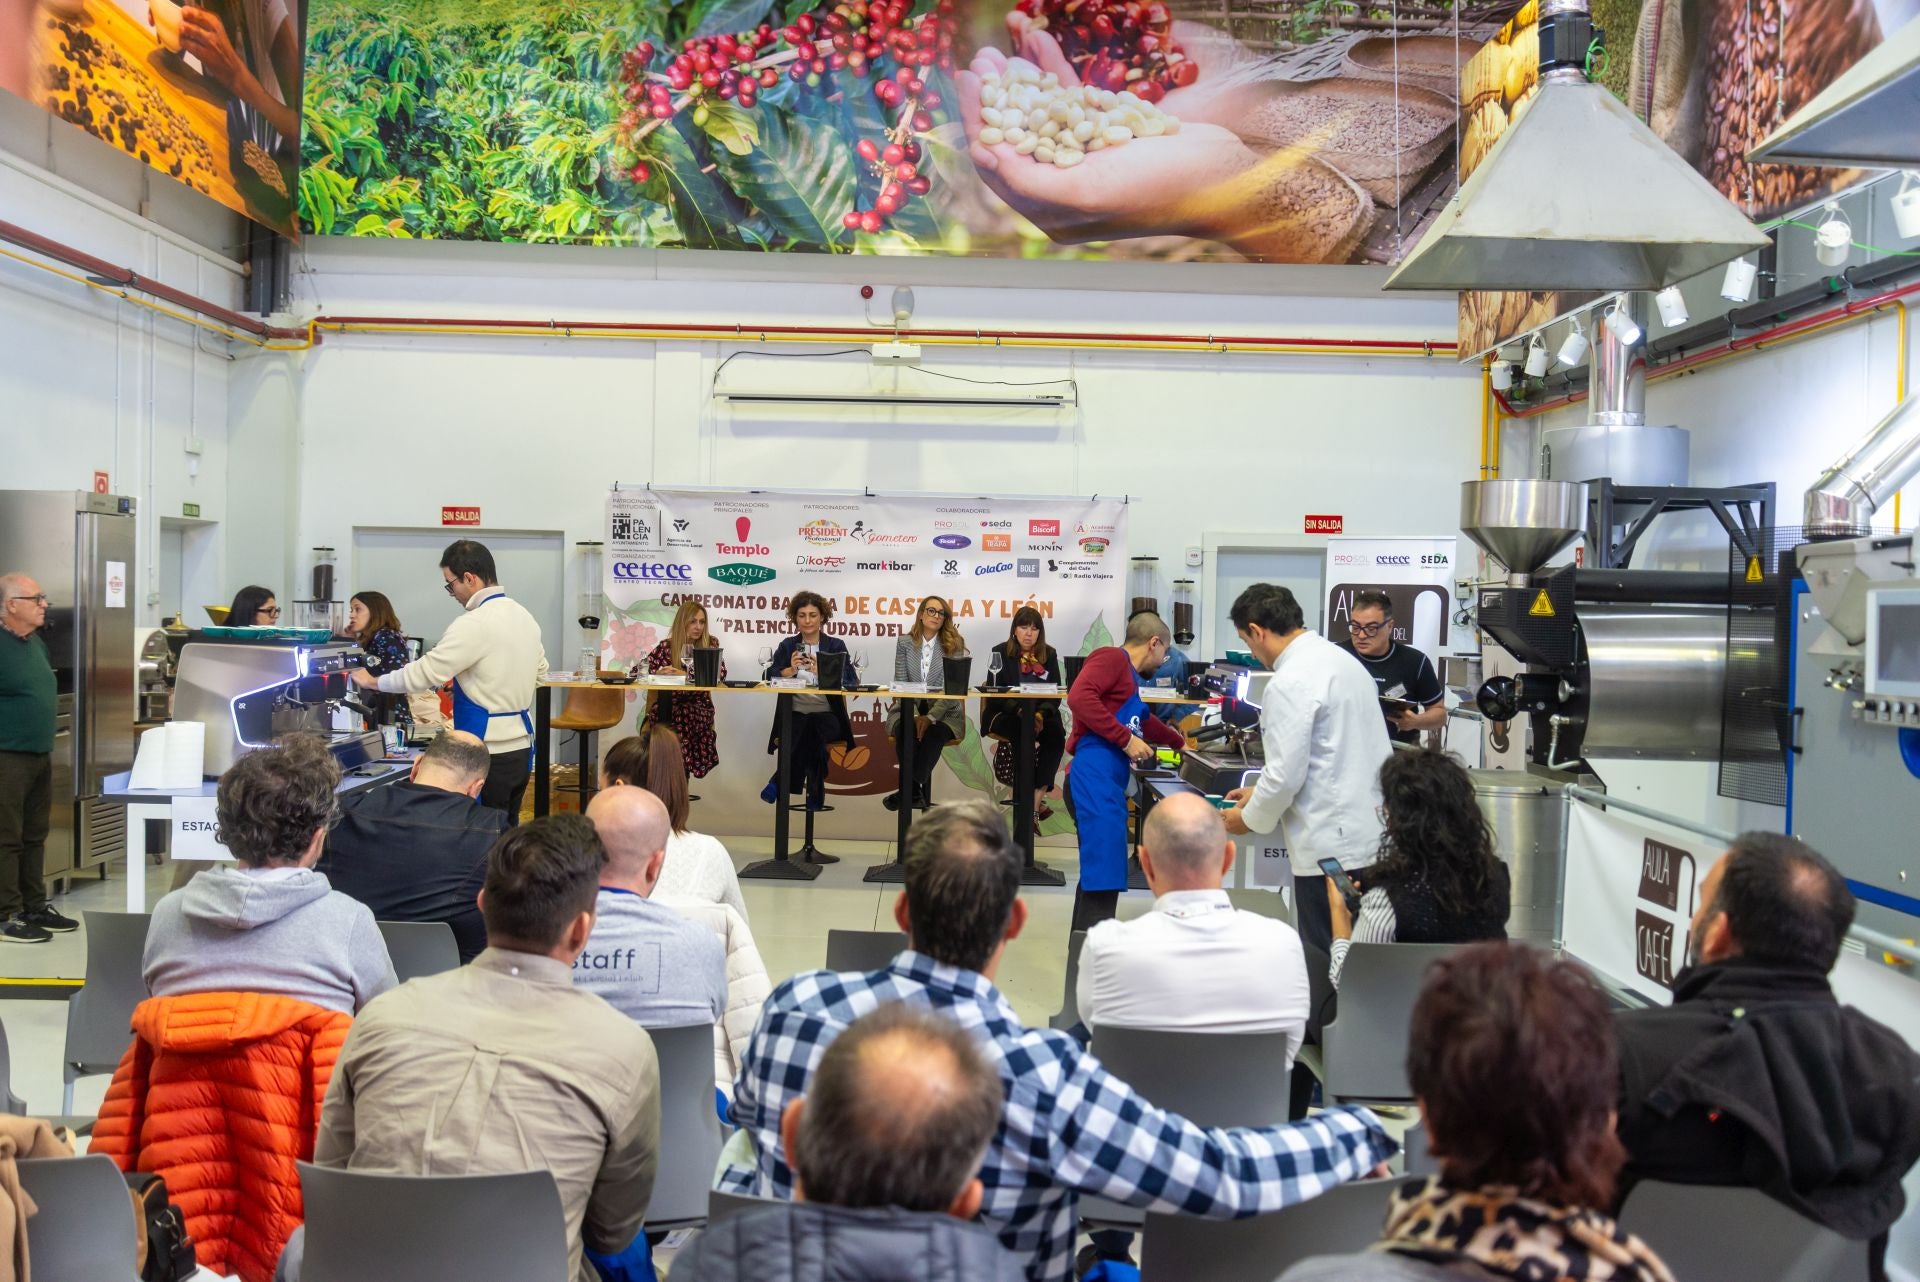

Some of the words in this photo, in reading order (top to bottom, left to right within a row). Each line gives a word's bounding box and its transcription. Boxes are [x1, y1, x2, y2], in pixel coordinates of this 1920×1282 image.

[443, 511, 454, 521] SIN
[455, 511, 480, 521] SALIDA
[988, 520, 1012, 528] seda
[1032, 525, 1056, 533] Biscoff
[1305, 519, 1317, 529] SIN
[1318, 519, 1342, 530] SALIDA
[798, 526, 848, 537] PRÉSIDENT
[715, 542, 770, 557] Templo
[1376, 555, 1410, 565] cetece
[1420, 555, 1449, 564] SEDA
[613, 562, 692, 580] cetece
[856, 560, 913, 571] markibar
[974, 562, 1013, 576] ColaCao
[715, 567, 769, 579] BAQUÉ
[845, 596, 870, 615] DE
[981, 599, 996, 618] Y
[1393, 627, 1408, 641] DEL
[1643, 844, 1670, 886] AULA
[1637, 925, 1670, 984] CAFÉ
